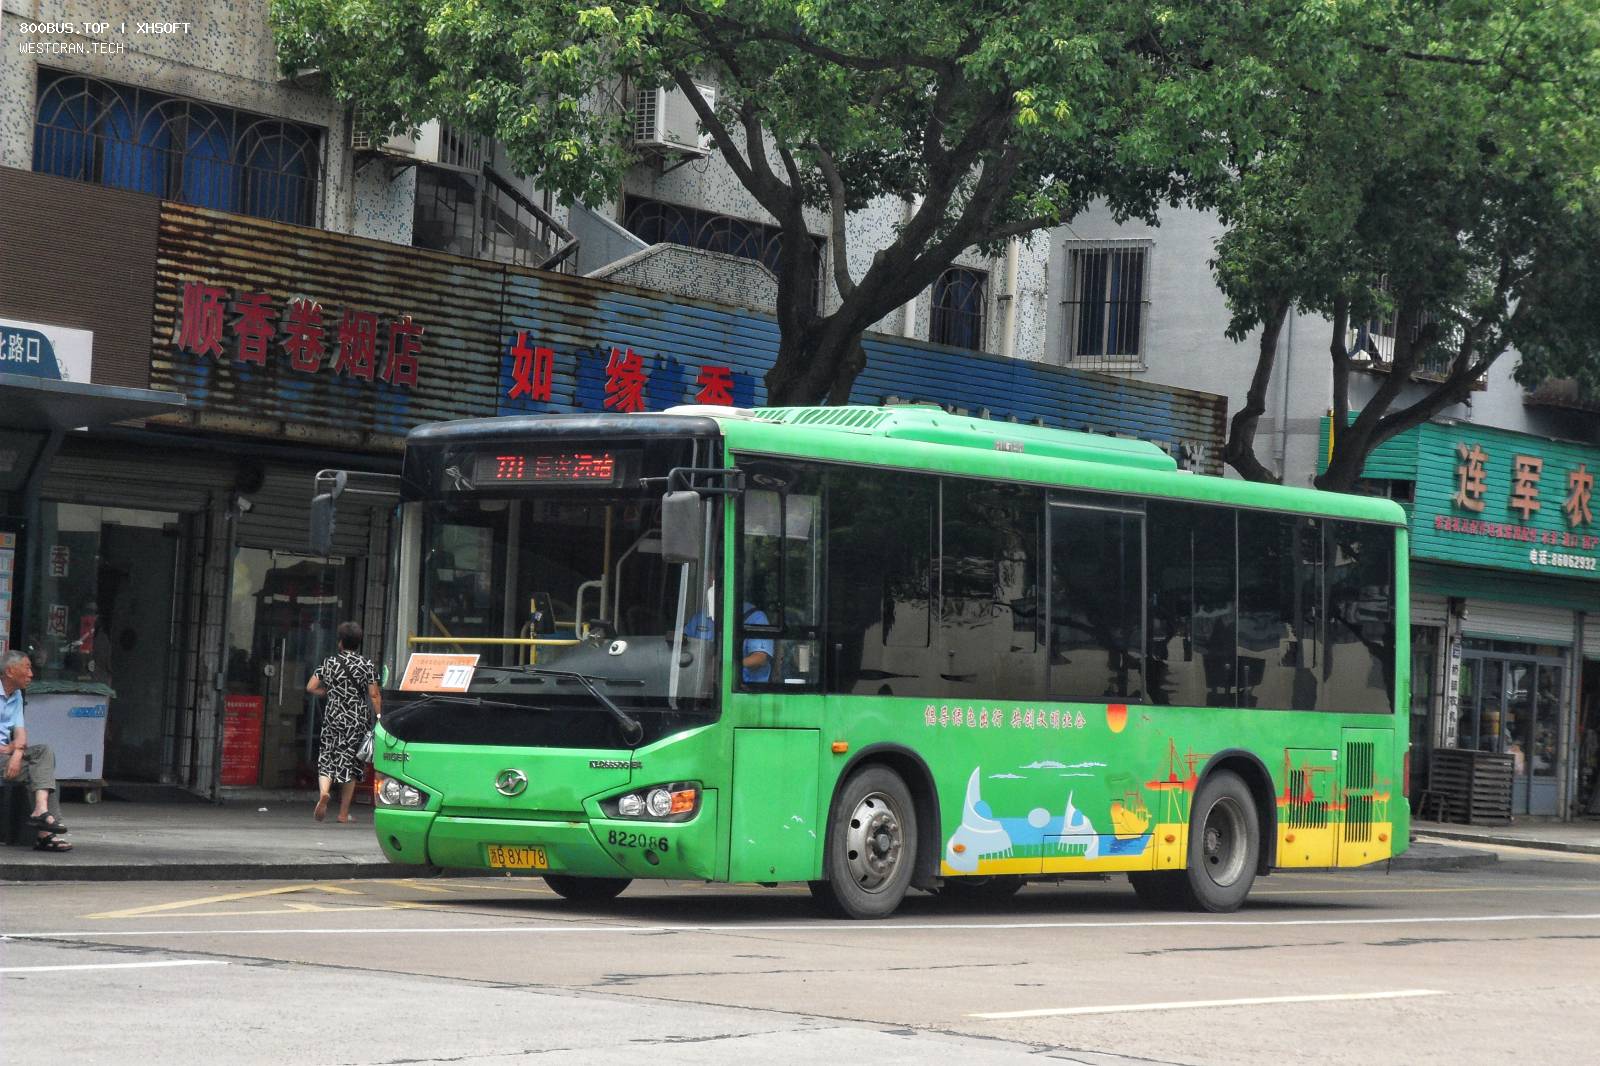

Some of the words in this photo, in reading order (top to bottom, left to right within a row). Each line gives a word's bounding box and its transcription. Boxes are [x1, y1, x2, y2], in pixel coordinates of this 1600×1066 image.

[177, 282, 423, 388] 顺香卷烟店
[1452, 440, 1594, 527] 连军农
[925, 704, 1003, 729] 倡导绿色出行
[1010, 706, 1087, 730] 共创文明北仑
[608, 829, 669, 853] 822086
